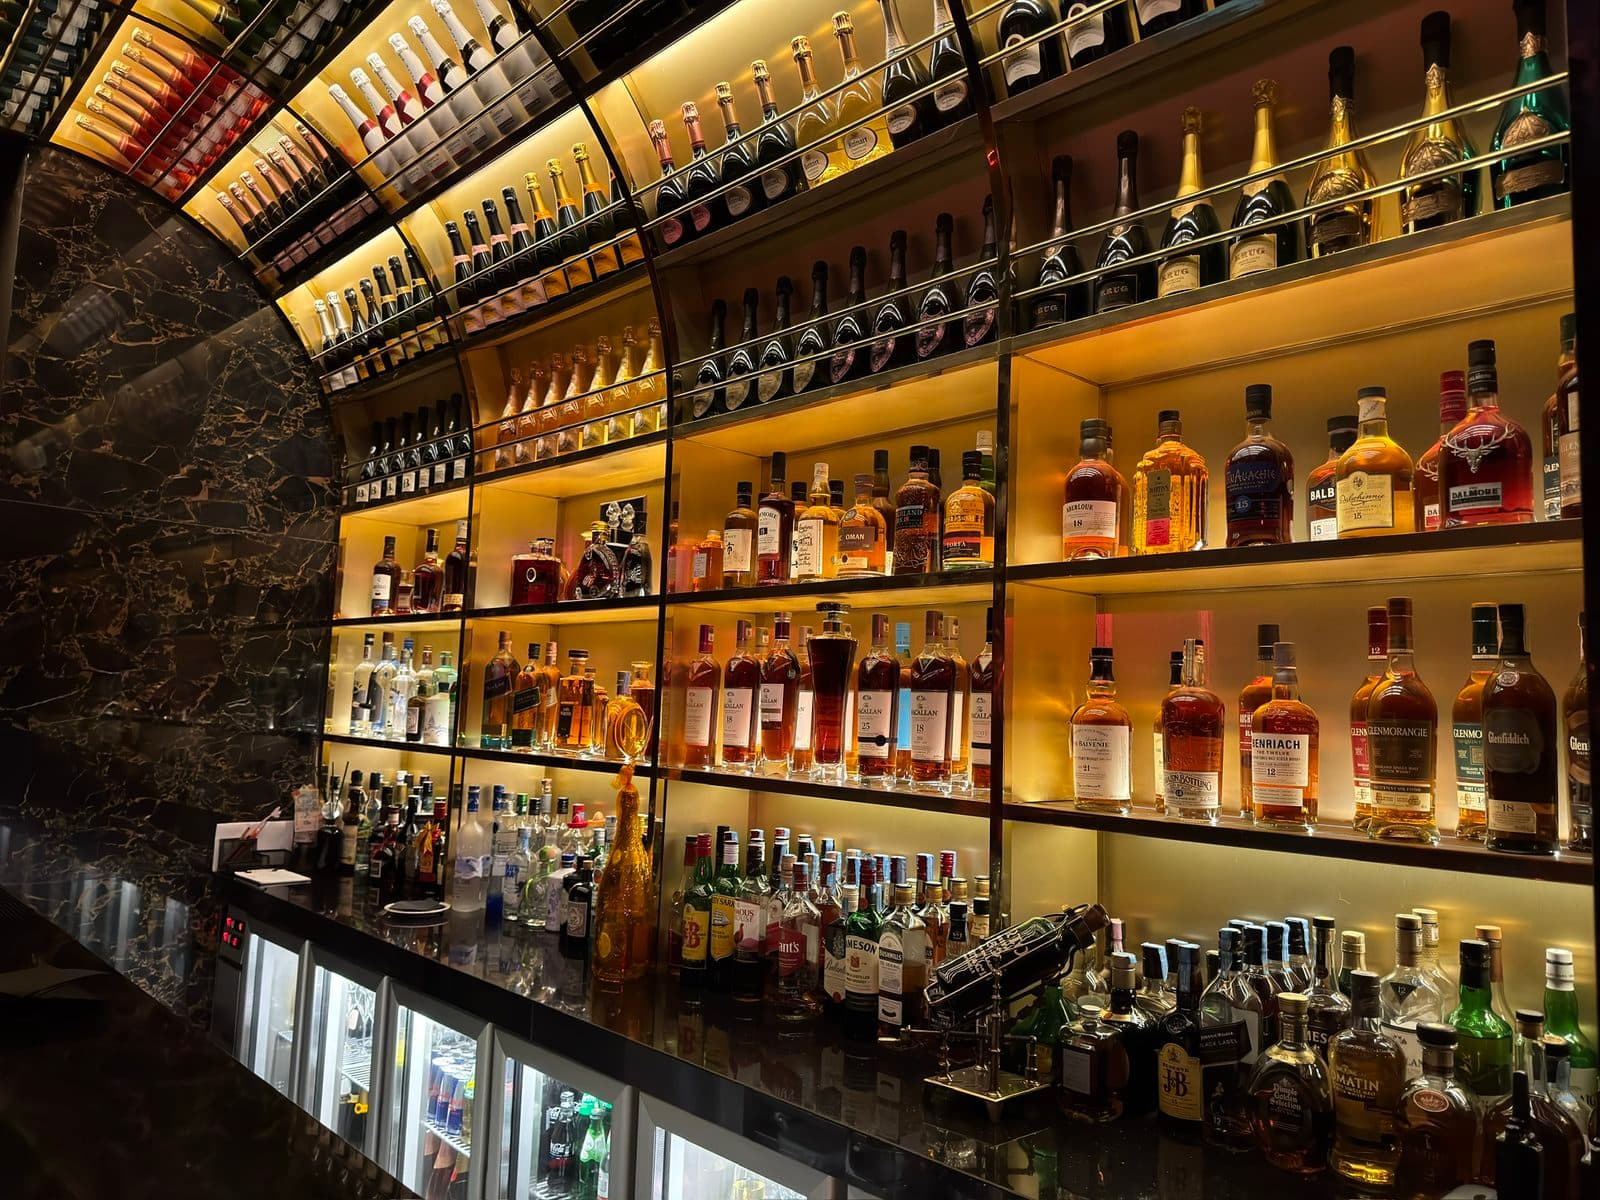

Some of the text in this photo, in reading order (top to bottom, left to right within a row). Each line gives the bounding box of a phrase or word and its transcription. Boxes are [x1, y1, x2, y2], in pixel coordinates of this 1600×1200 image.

[1451, 487, 1499, 500] DALMORE
[1313, 525, 1322, 536] 15
[1367, 726, 1428, 737] GLENMORANGIE
[1488, 731, 1530, 745] Glenfiddich
[1267, 768, 1276, 776] 12
